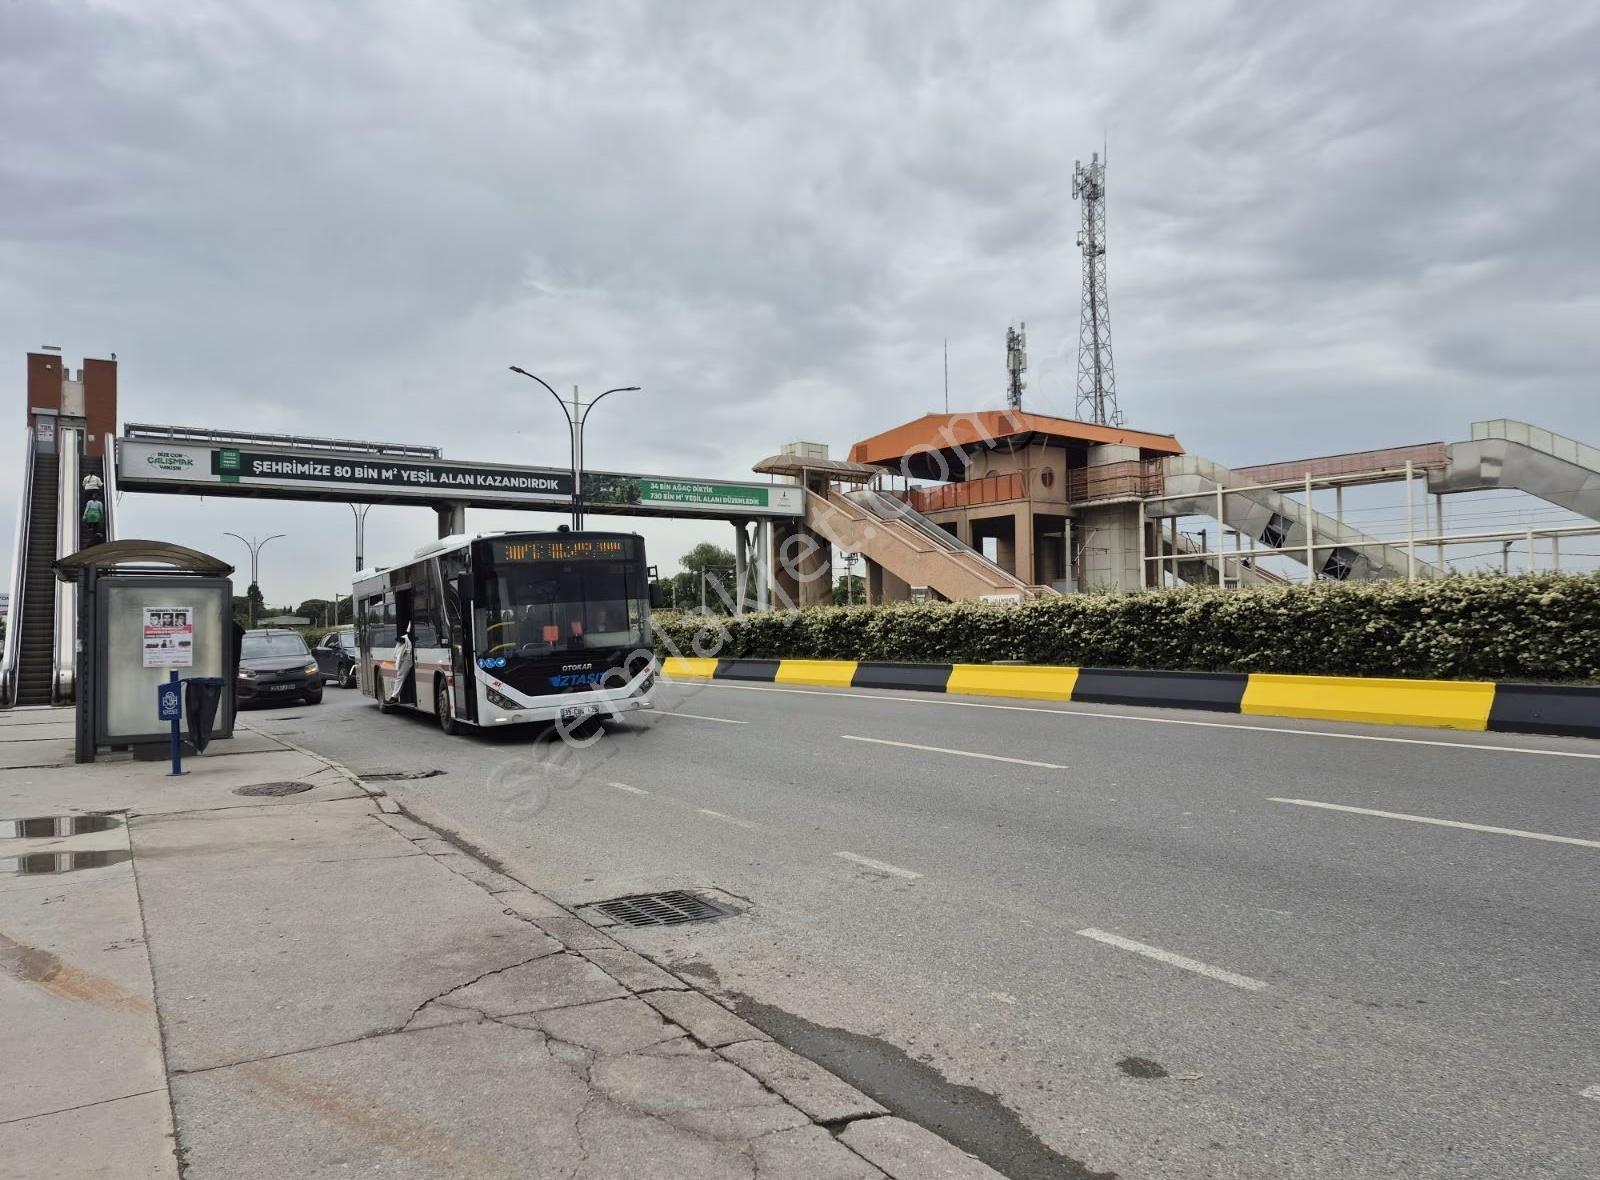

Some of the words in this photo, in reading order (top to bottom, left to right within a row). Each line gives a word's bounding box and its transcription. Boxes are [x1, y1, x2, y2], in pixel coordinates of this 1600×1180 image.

[252, 459, 331, 475] ŞEHRİMİZE
[333, 465, 351, 478] 80
[354, 464, 378, 479] BİN
[401, 469, 437, 484] YEŞİL
[439, 472, 475, 485] ALAN
[476, 475, 559, 490] KAZANDIRDIK
[650, 492, 663, 500] 730
[562, 663, 592, 671] OTOKAR
